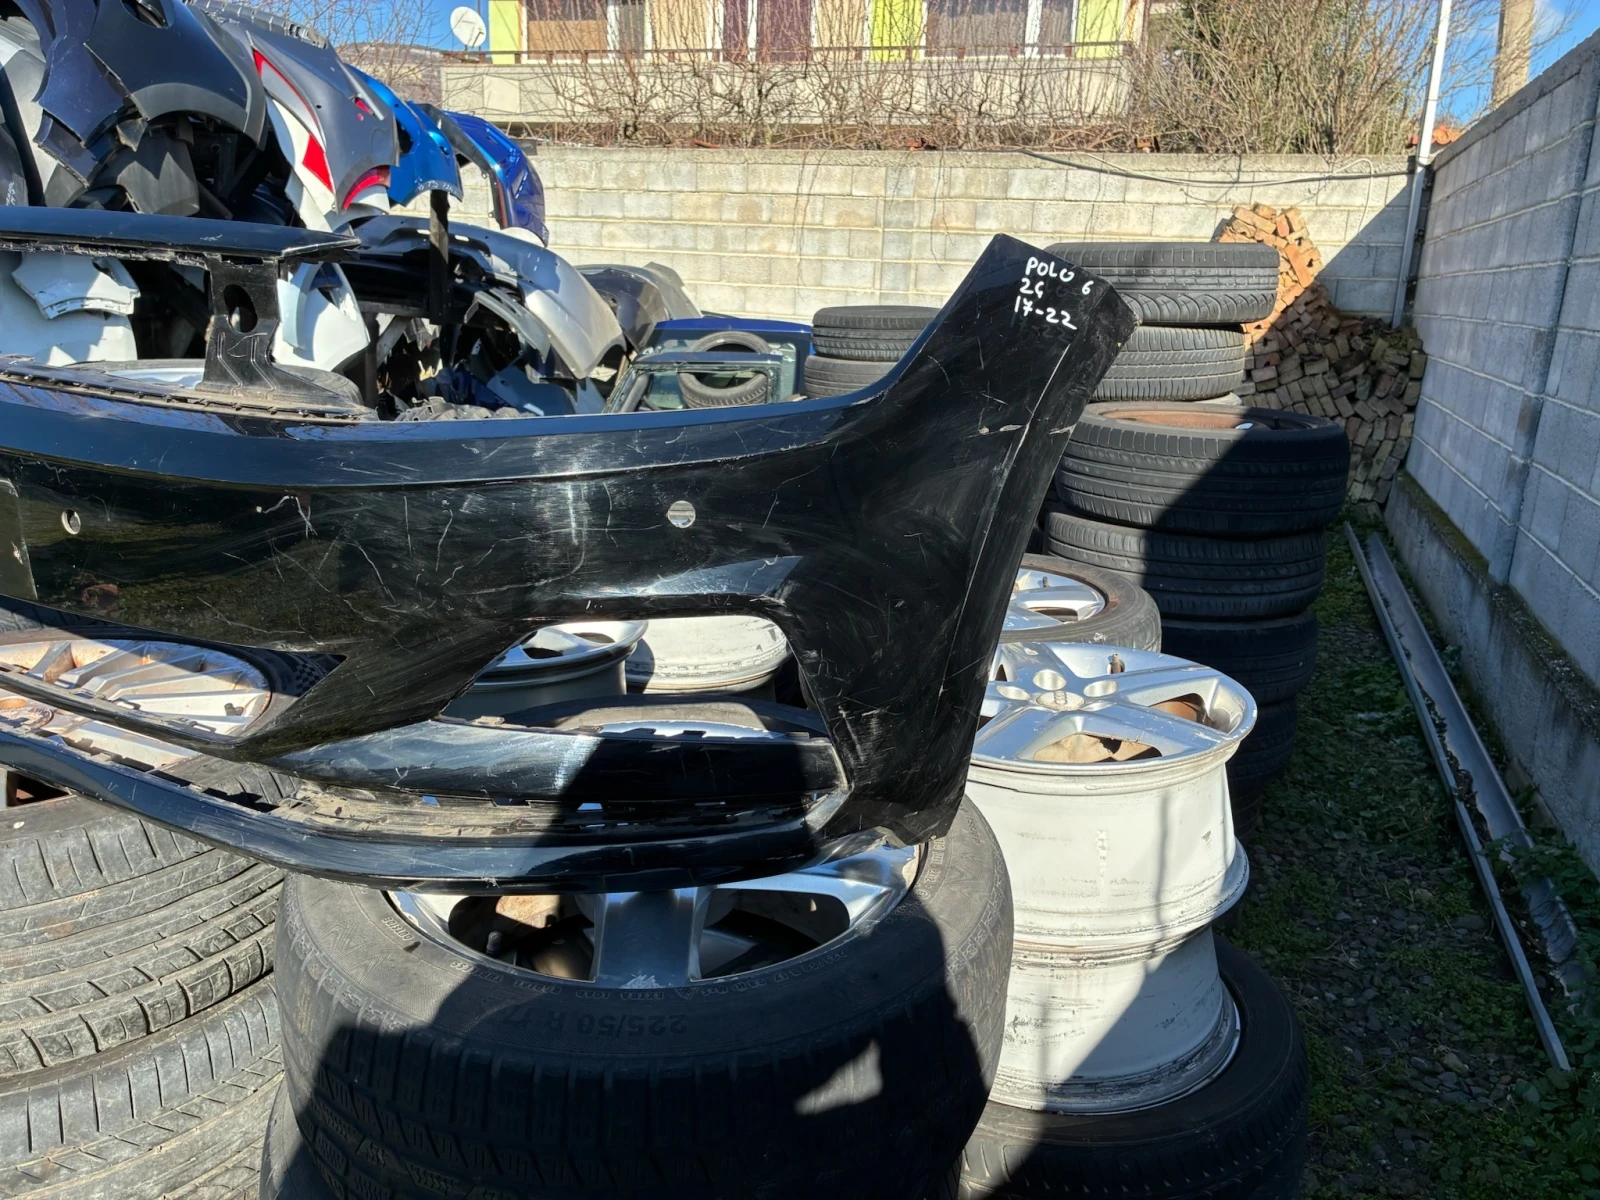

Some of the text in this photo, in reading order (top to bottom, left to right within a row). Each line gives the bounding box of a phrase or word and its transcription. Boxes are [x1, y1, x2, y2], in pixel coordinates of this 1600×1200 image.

[1025, 257, 1075, 281] POLO
[1081, 280, 1094, 295] 6
[1014, 295, 1078, 331] 17-22
[382, 916, 415, 942] OUTSIDE
[450, 961, 665, 1000] EXTRA LOAD RADIAL TUBELESS
[503, 1005, 687, 1037] 225/50 R 17
